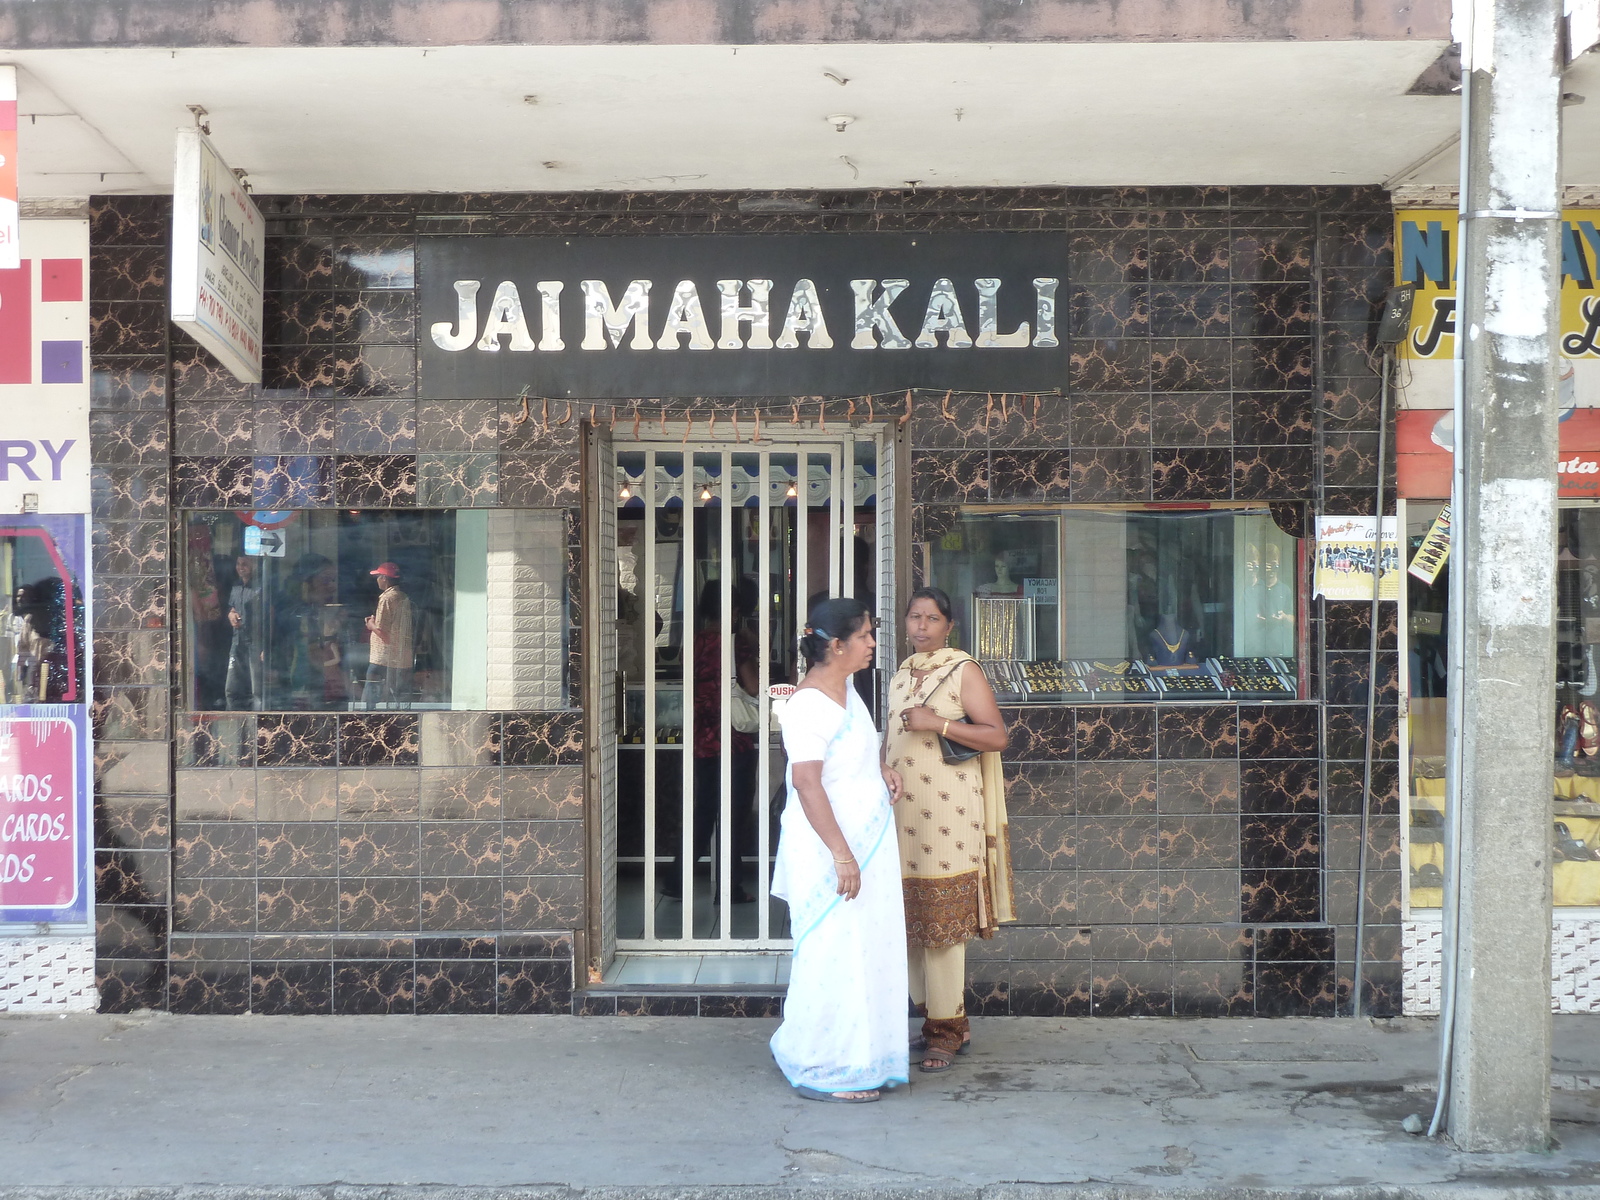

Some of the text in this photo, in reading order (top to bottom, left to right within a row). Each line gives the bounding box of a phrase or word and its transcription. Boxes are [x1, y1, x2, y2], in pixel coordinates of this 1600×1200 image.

[430, 277, 1060, 352] JAI MAHA KALI
[0, 439, 77, 482] RY
[769, 686, 796, 697] PUSH
